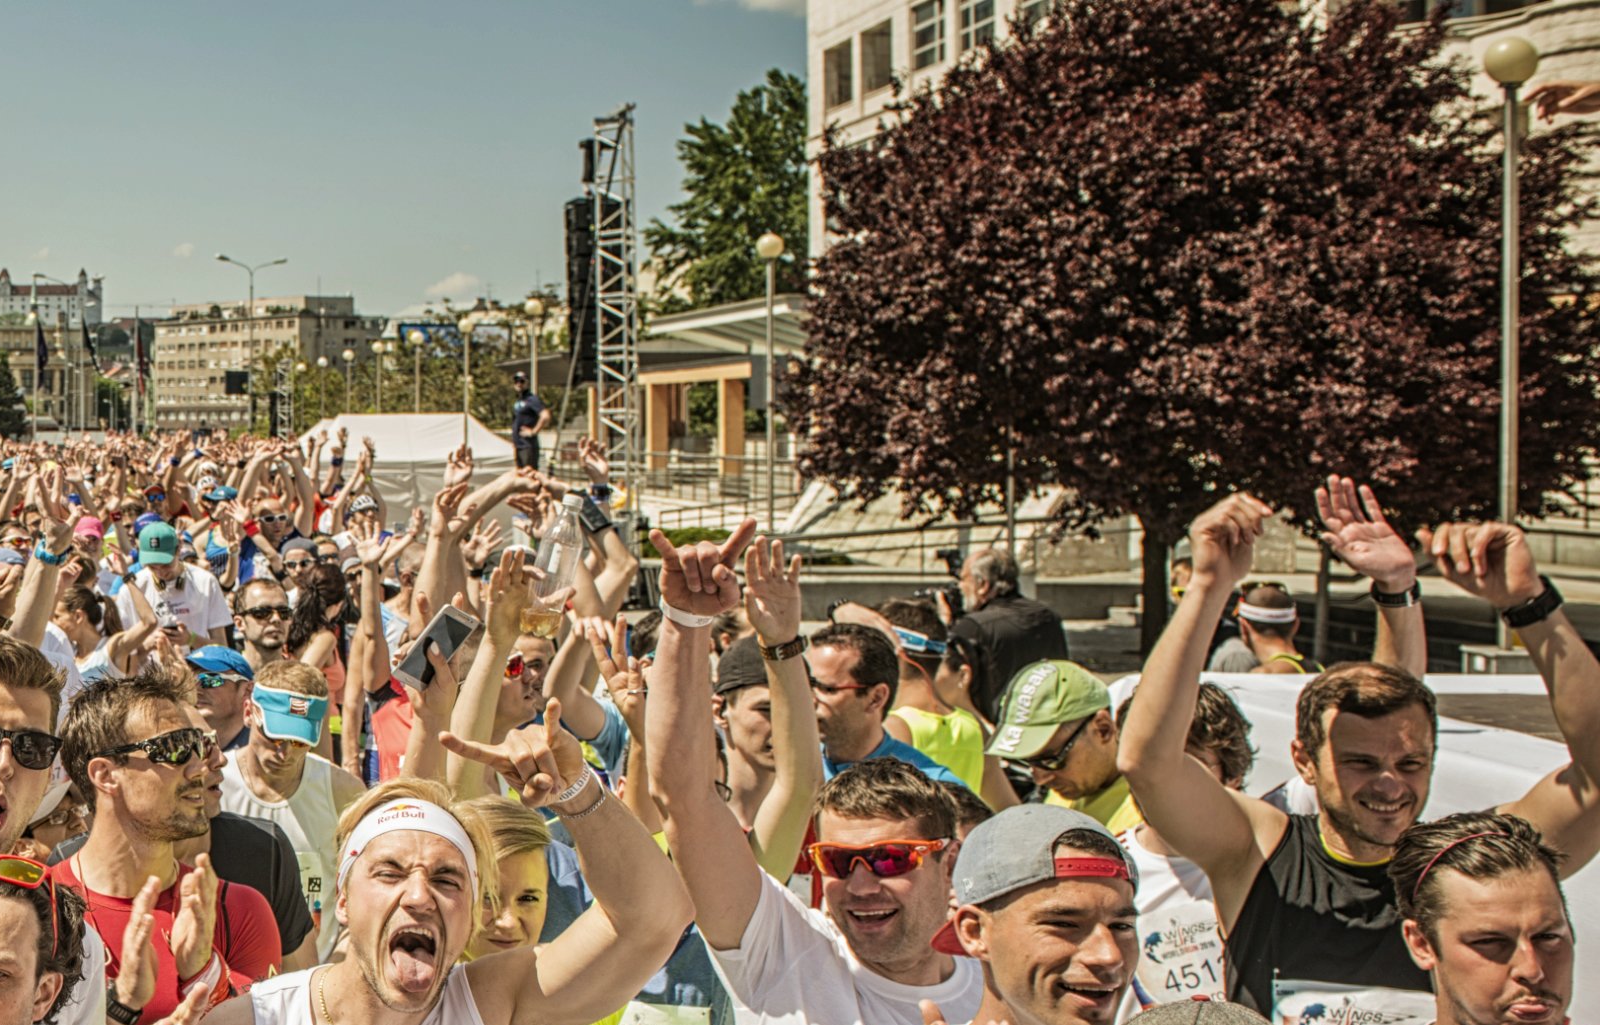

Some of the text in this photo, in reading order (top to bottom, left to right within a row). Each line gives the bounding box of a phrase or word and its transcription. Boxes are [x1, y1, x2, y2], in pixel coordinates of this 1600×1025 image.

[401, 807, 425, 822] Bull
[1164, 922, 1206, 941] WINGS
[1329, 1007, 1383, 1023] WINGS
